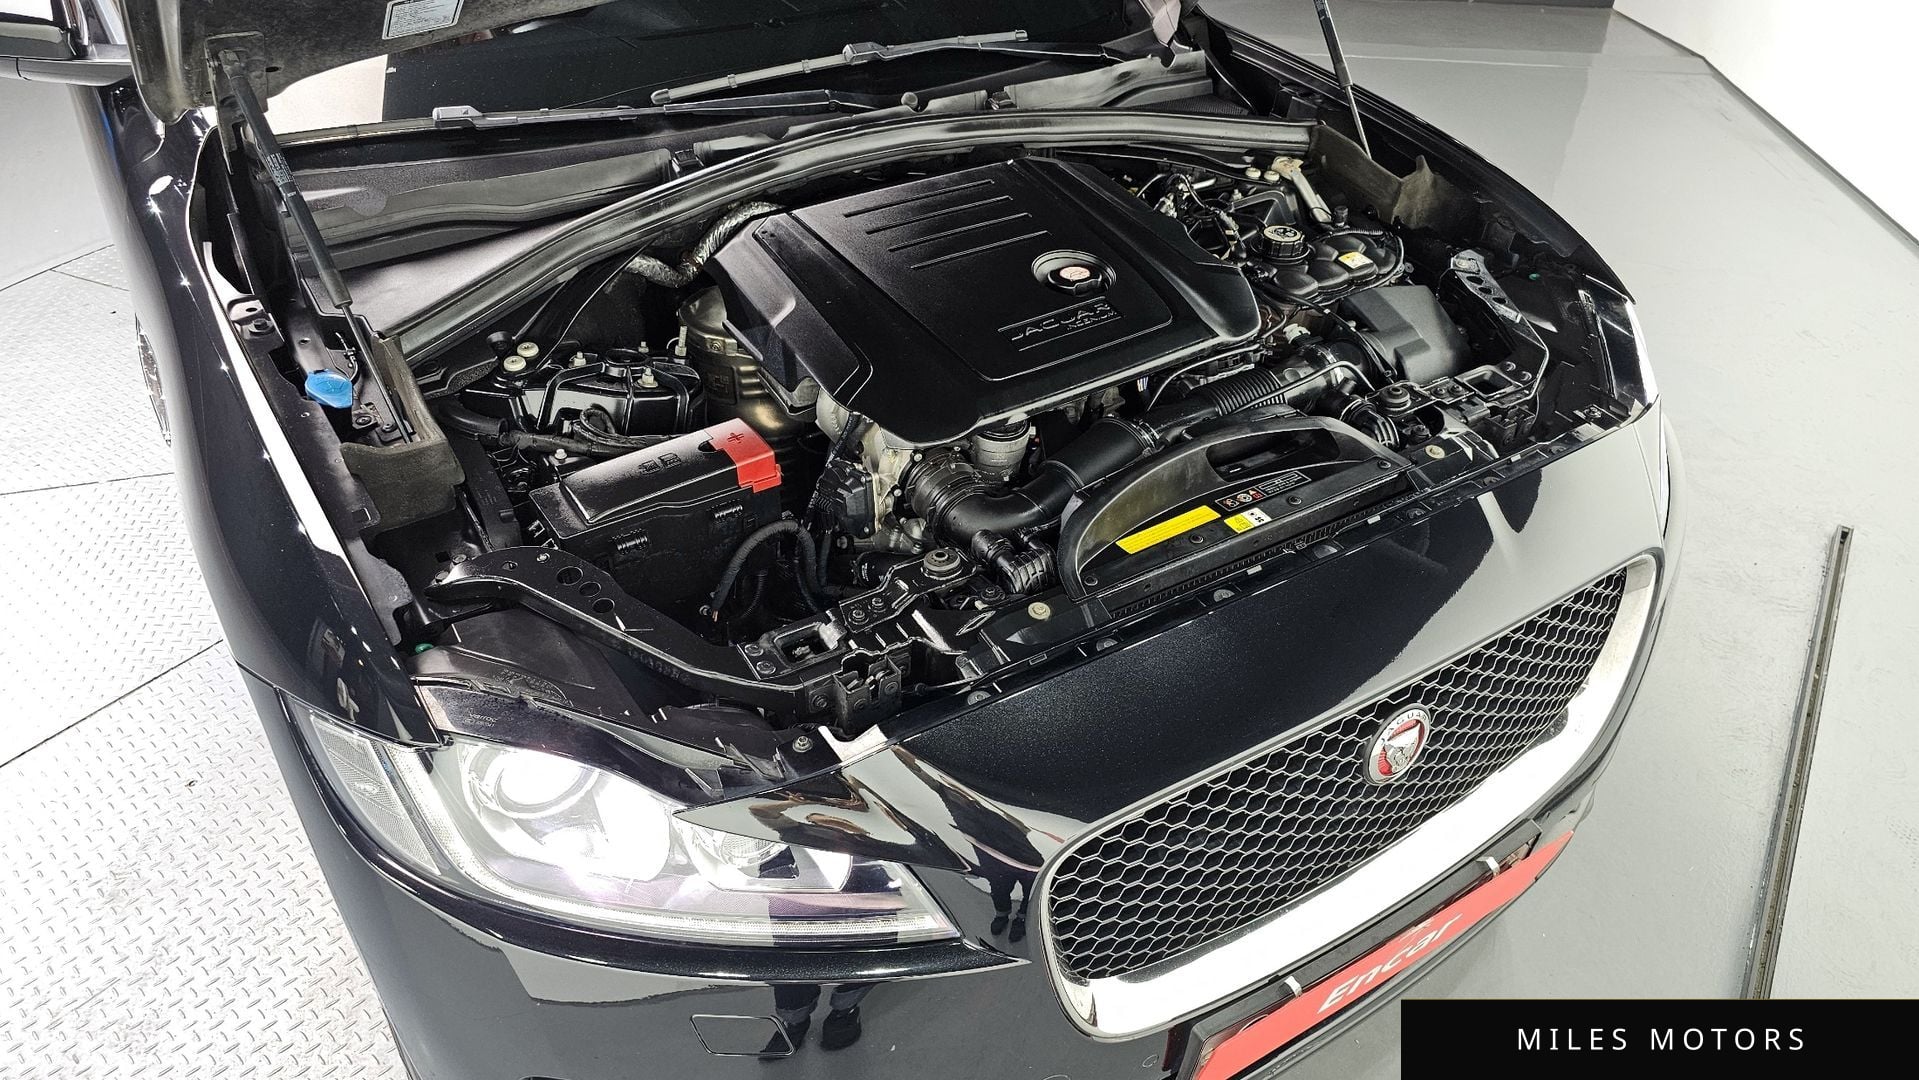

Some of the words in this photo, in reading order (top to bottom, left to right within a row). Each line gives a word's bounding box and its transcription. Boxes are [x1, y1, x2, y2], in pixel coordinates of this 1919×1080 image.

[1010, 302, 1111, 341] JAGUAR
[1380, 711, 1427, 746] JAGUAR
[1317, 913, 1463, 1004] Encar
